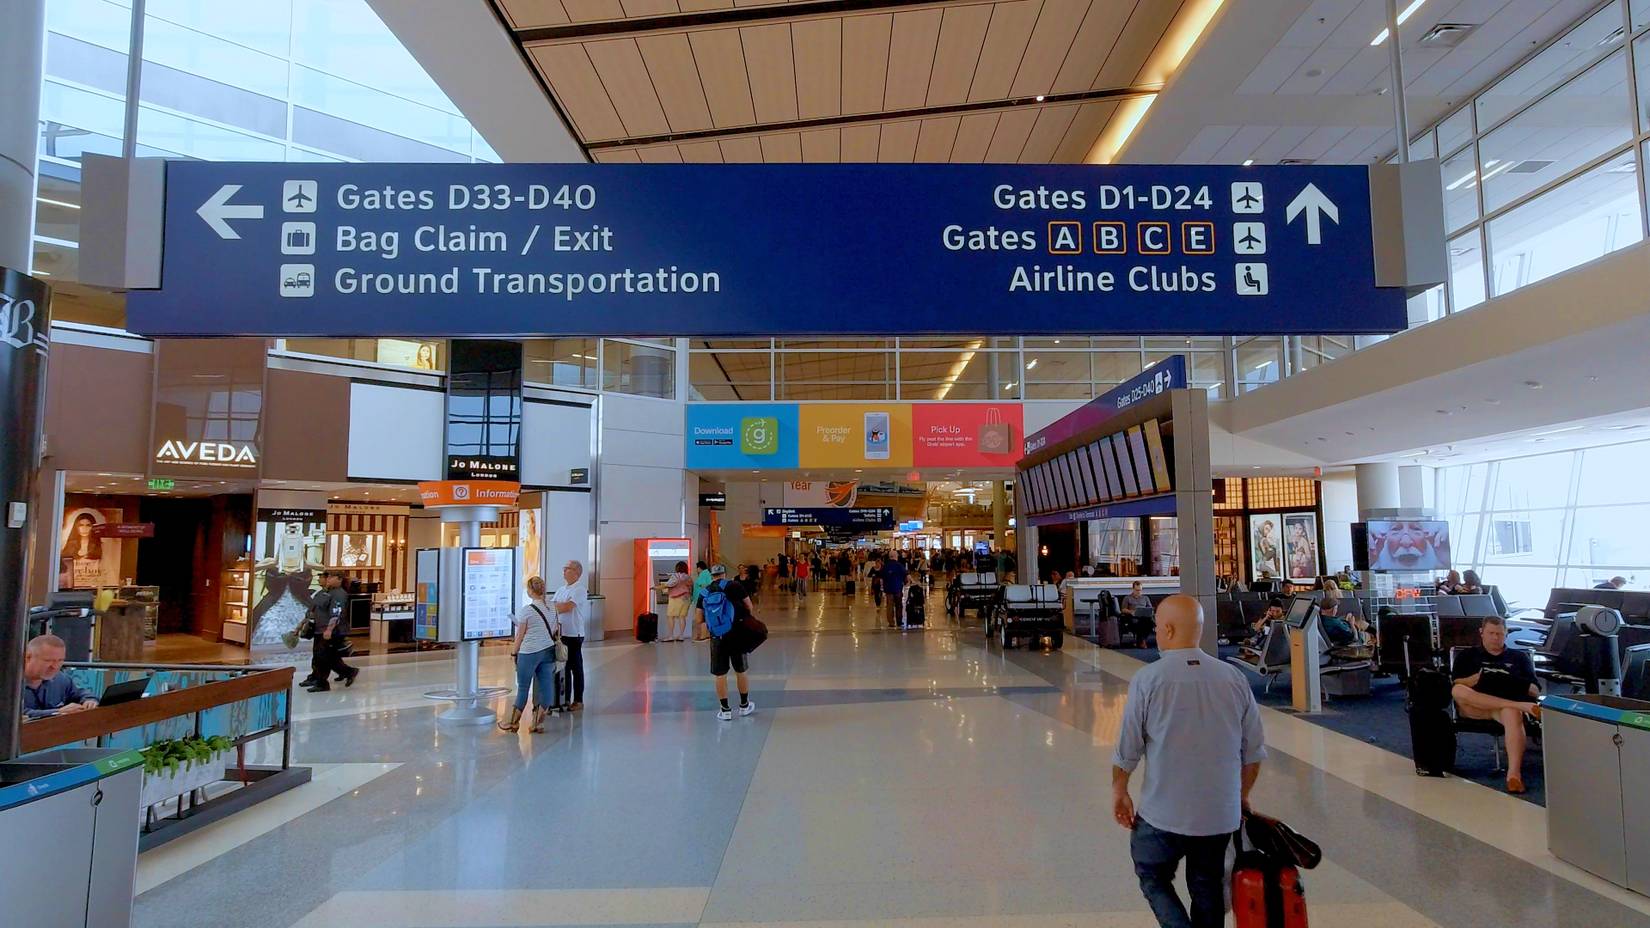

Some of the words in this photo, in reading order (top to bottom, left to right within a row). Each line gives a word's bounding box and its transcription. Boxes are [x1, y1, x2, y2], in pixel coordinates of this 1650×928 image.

[337, 184, 434, 210] Gates
[448, 184, 596, 210] D33-D40
[994, 184, 1086, 210] Gates
[1100, 184, 1213, 210] D1-D24
[336, 225, 399, 259] Bag
[414, 224, 507, 252] Claim
[521, 225, 540, 256] /
[554, 224, 613, 251] Exit
[943, 224, 1036, 250] Gates
[1055, 226, 1076, 249] A
[1101, 226, 1119, 249] B
[1144, 226, 1163, 250] C
[1190, 227, 1207, 250] E
[334, 267, 459, 294] Ground
[472, 265, 720, 301] Transportation
[1009, 265, 1115, 292] Airline
[1128, 265, 1216, 292] Clubs
[1116, 394, 1131, 409] Gates
[694, 426, 734, 435] Download
[816, 425, 851, 434] Preorder
[831, 434, 846, 443] Pay
[931, 425, 947, 433] Pick
[949, 425, 961, 434] Up
[156, 439, 256, 463] AVEDA
[469, 460, 516, 471] MALONE
[790, 480, 812, 491] Year
